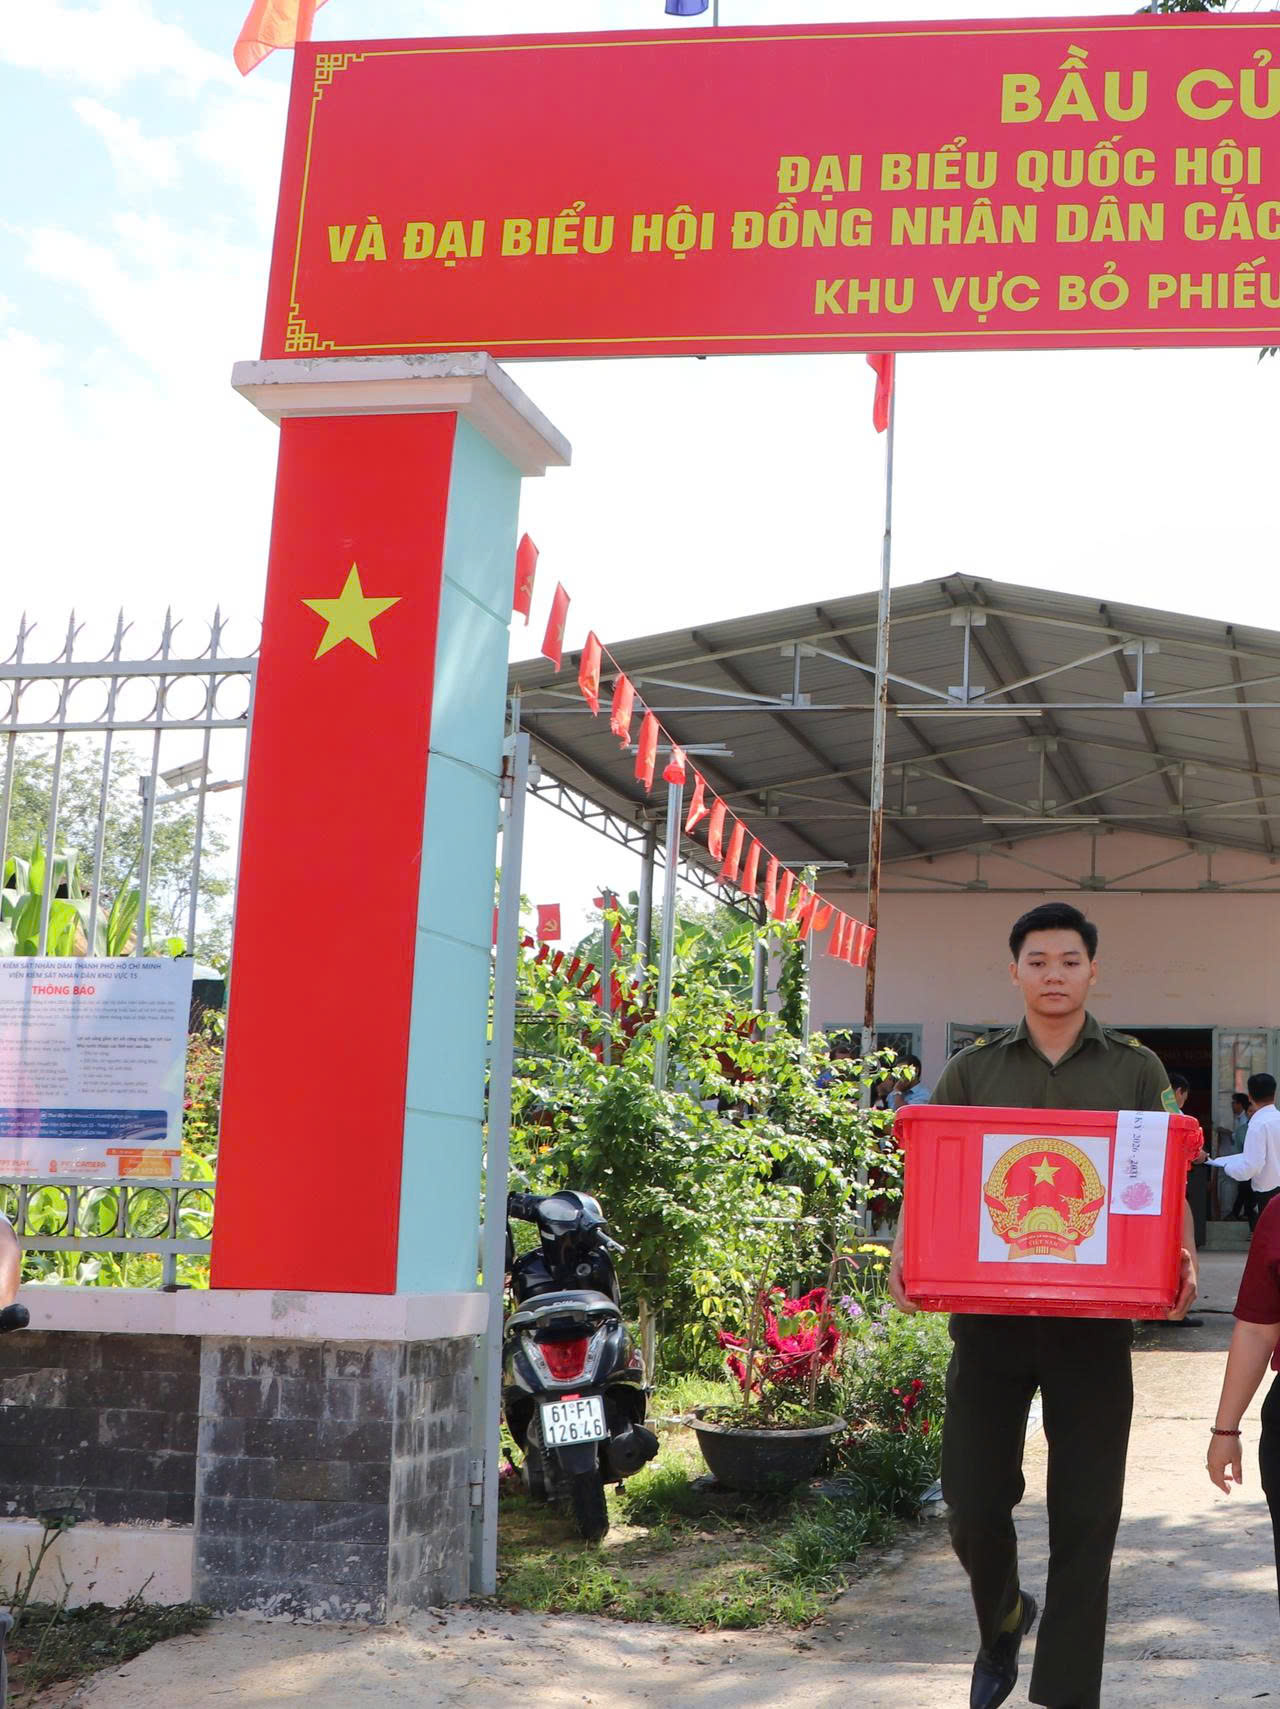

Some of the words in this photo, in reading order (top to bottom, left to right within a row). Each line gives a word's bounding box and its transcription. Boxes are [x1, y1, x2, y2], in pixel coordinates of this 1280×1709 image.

[1002, 45, 1148, 122] BẦU
[777, 155, 862, 196] ĐẠI
[881, 136, 998, 190] BIỂU
[1017, 135, 1156, 192] QUỐC
[1176, 139, 1260, 187] HỘI
[327, 217, 386, 262] VÀ
[403, 220, 485, 267] ĐẠI
[502, 200, 614, 256] BIỂU
[631, 205, 714, 261] HỘI
[731, 196, 873, 249] ĐỒNG
[891, 197, 1036, 245] NHÂN
[1057, 195, 1164, 243] DÂN
[815, 279, 914, 314] KHU
[933, 271, 1039, 322] VỰC
[1059, 260, 1128, 311] BỎ
[549, 1418, 602, 1443] 126.46
[551, 1400, 593, 1423] 61-F1
